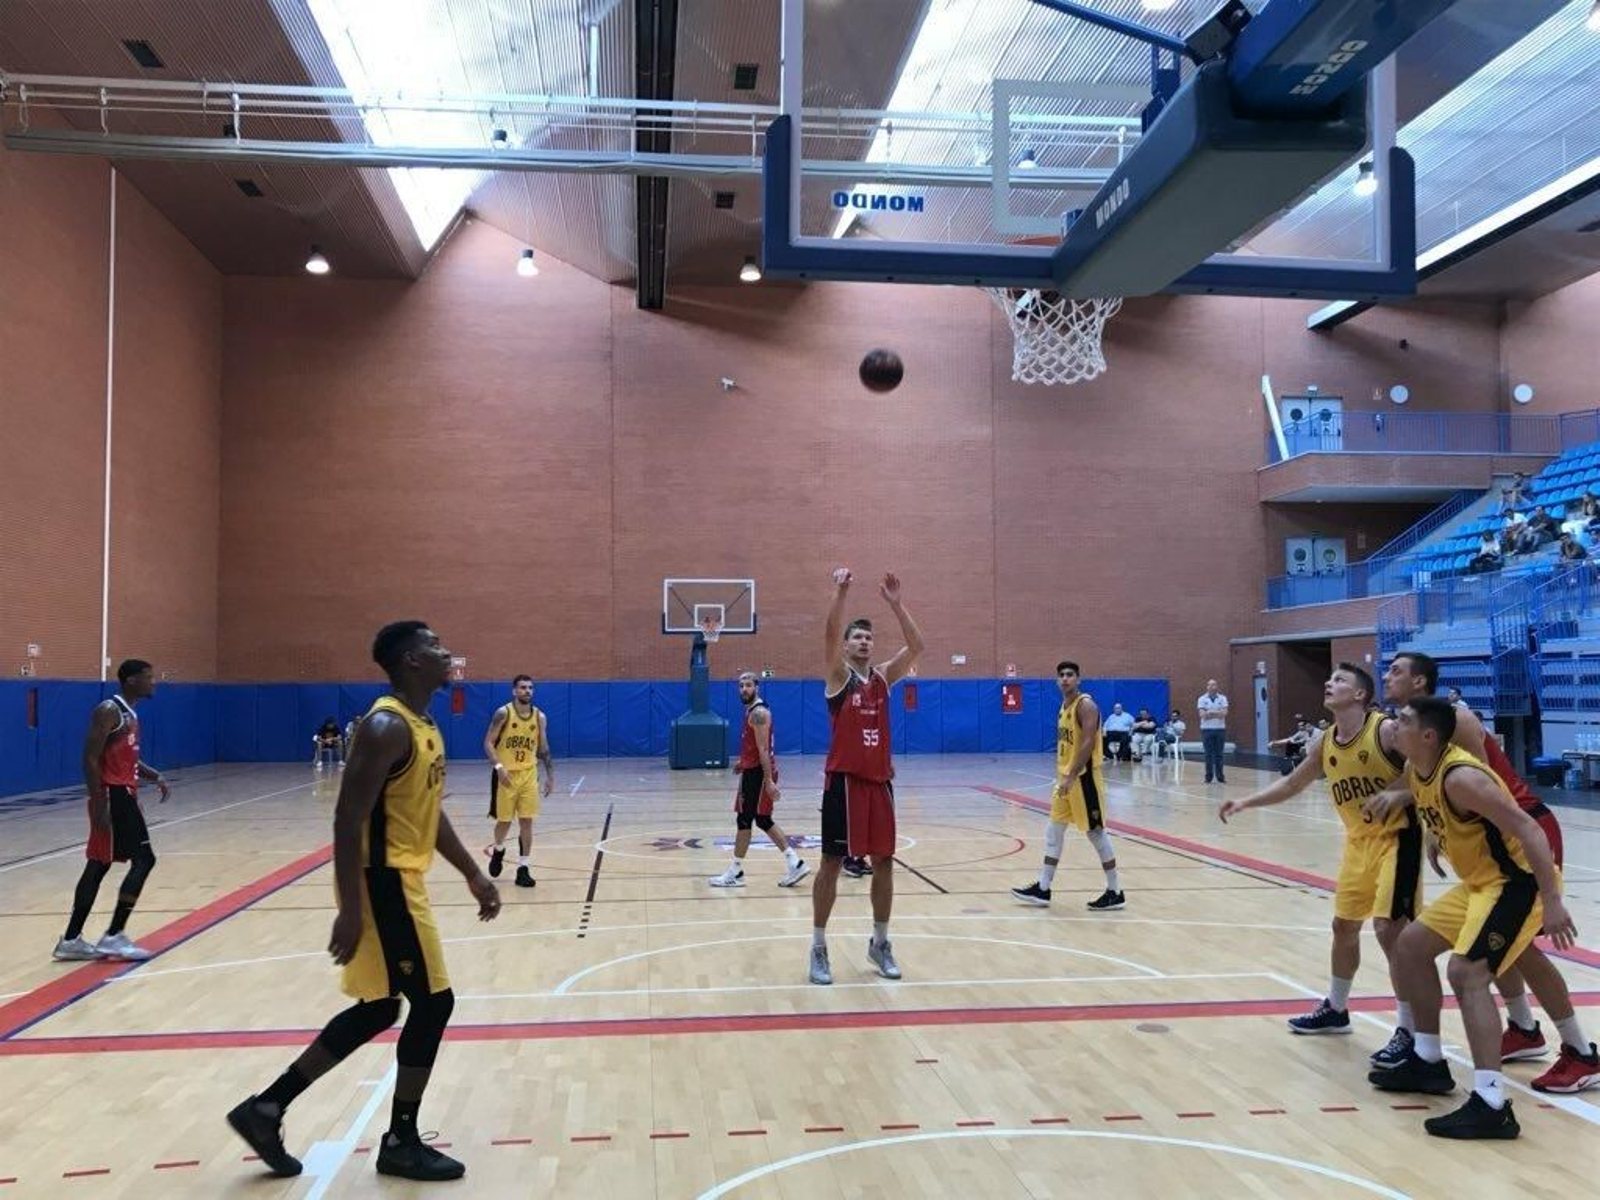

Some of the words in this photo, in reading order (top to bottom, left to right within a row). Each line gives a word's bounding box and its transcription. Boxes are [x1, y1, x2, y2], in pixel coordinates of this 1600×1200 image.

[1095, 177, 1130, 230] MONDO
[862, 728, 879, 747] 55
[514, 750, 526, 763] 13
[1331, 776, 1387, 806] OBRAS
